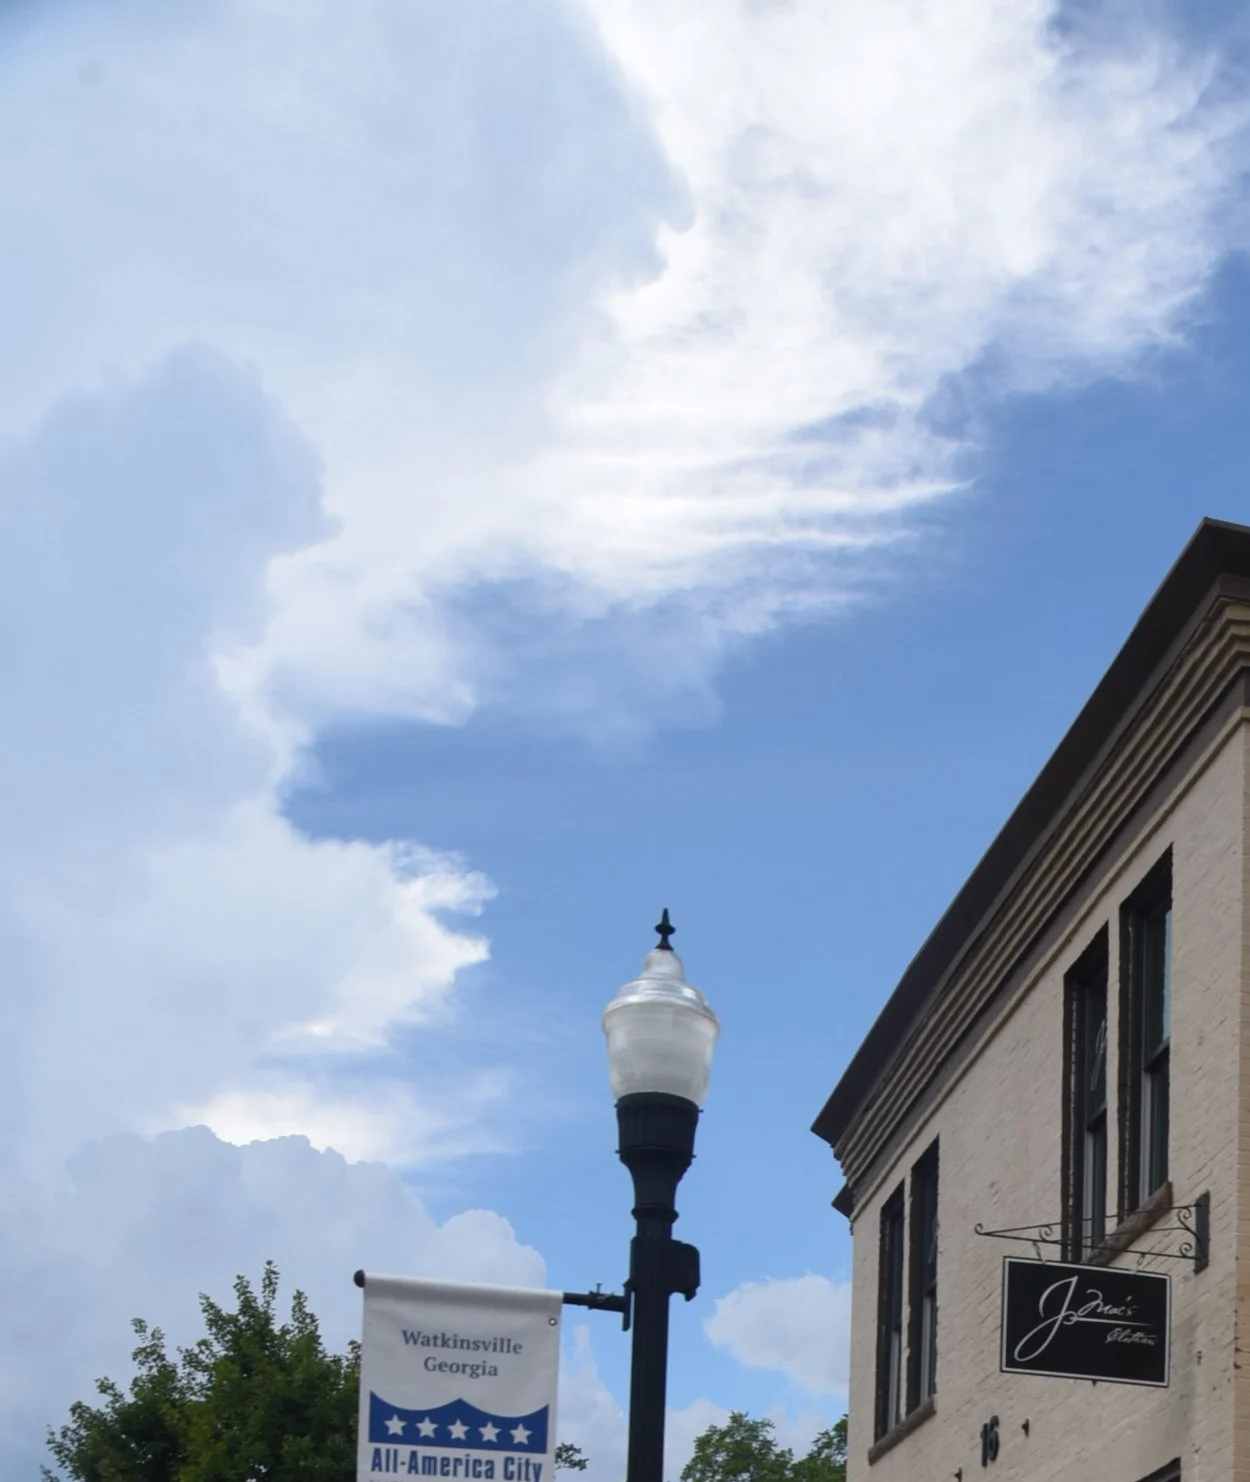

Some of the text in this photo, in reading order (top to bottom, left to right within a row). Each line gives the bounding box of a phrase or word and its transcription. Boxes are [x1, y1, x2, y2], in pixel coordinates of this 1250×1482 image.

[401, 1329, 523, 1355] Watkinsville
[423, 1356, 498, 1379] Georgia
[370, 1447, 495, 1480] All-America
